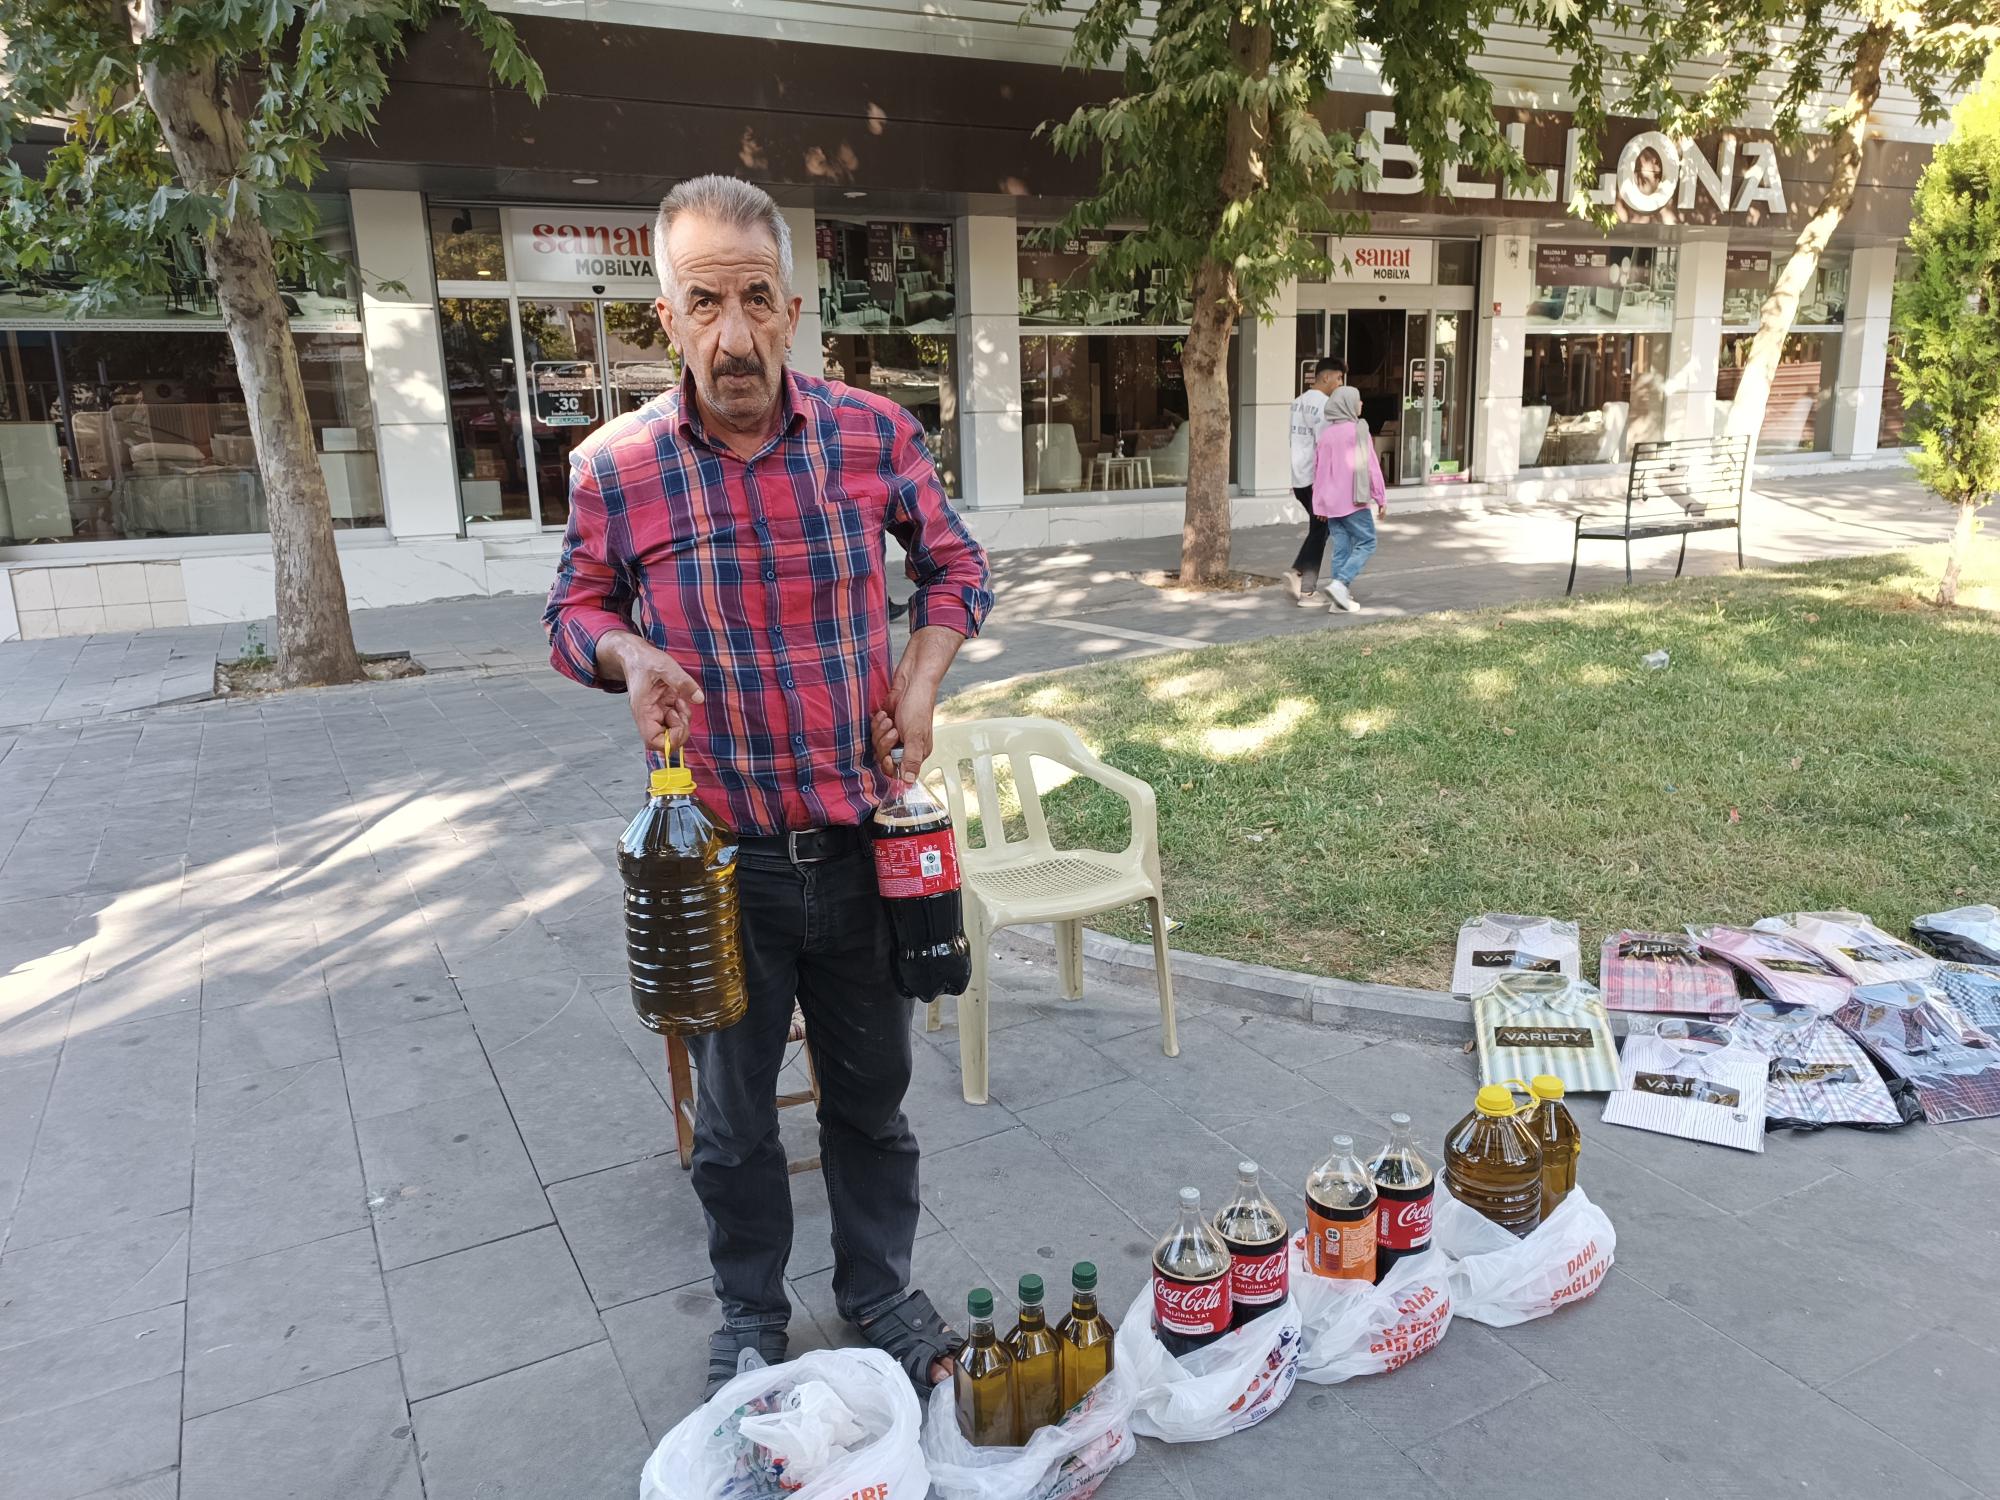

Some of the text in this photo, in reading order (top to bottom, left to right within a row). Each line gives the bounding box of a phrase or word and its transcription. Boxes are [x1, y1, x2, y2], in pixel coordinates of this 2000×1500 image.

[1357, 110, 1788, 215] BELLONA
[532, 222, 651, 257] sanat
[1354, 246, 1411, 267] sanat
[1504, 1032, 1582, 1041] VARIETY
[1567, 1240, 1597, 1277] DAHA
[1154, 1277, 1223, 1311] Coca-Cola
